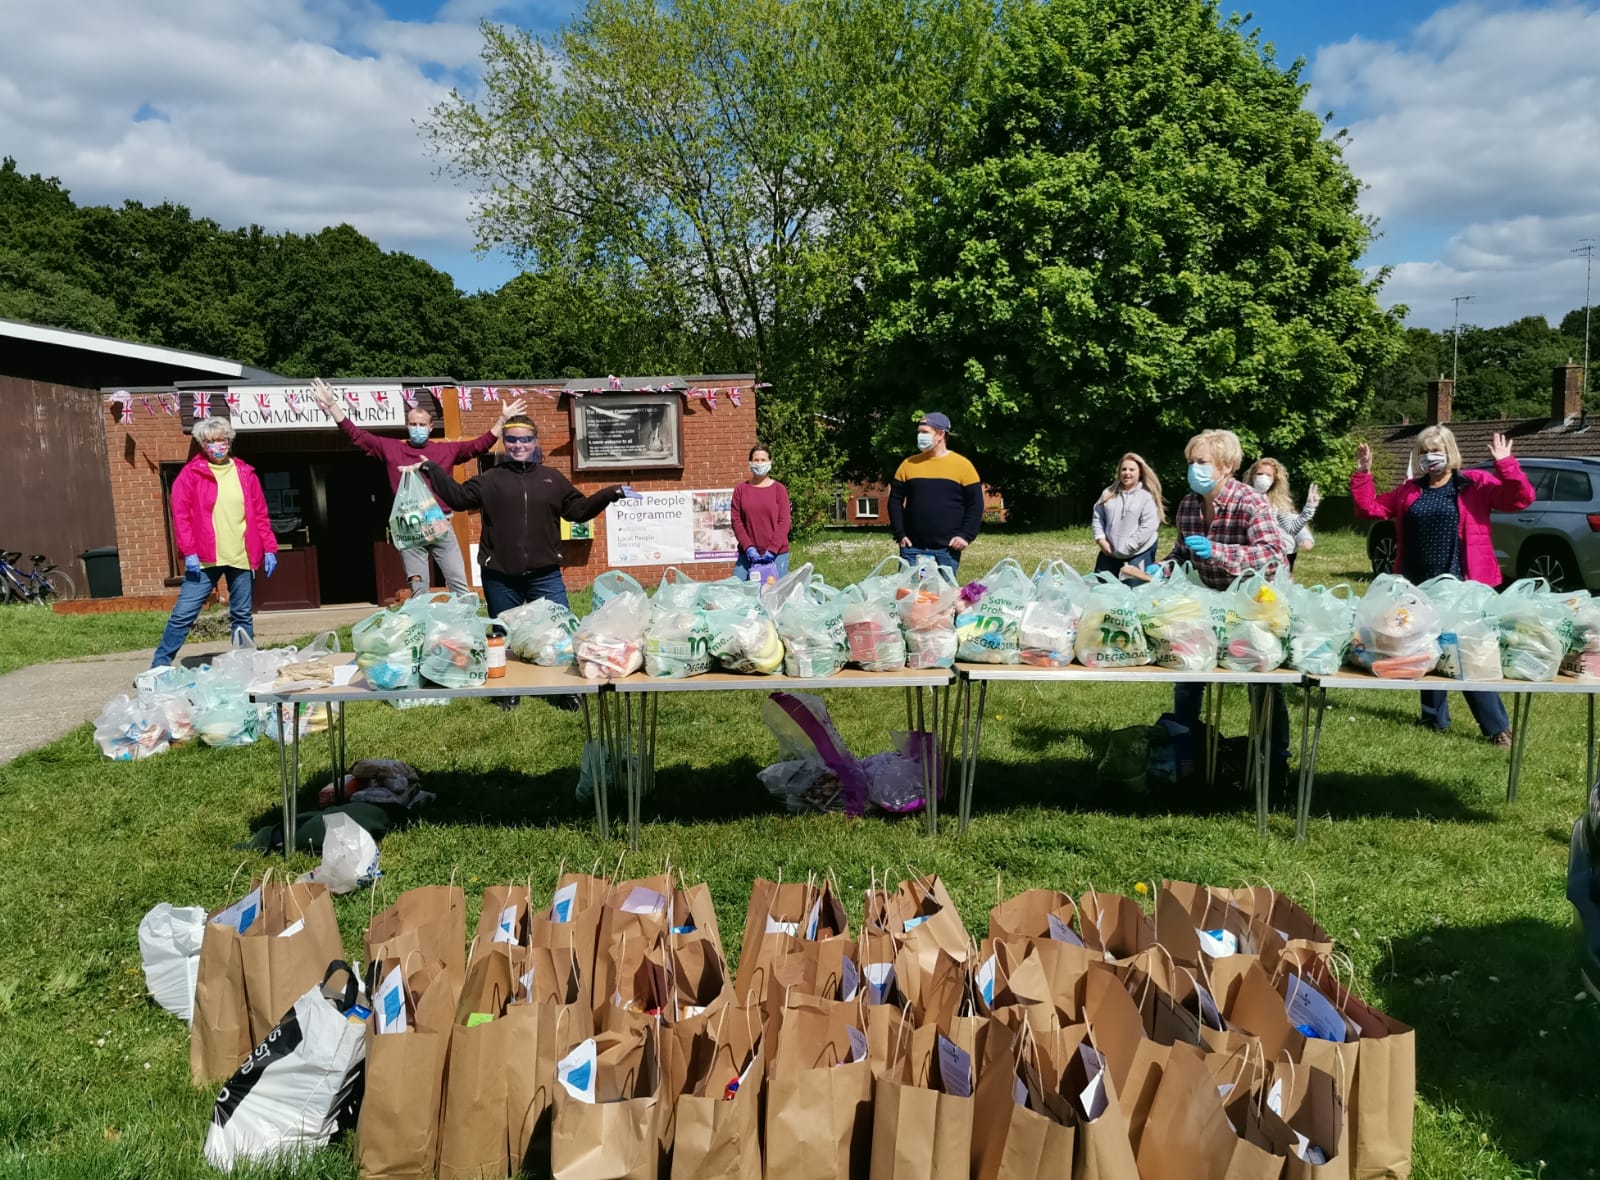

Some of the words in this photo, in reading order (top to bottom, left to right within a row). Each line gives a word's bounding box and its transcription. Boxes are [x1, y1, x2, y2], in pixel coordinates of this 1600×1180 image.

[284, 387, 348, 403] HARST
[240, 407, 331, 425] COMMUNITY
[342, 407, 396, 423] CHURCH
[646, 495, 686, 508] People
[617, 510, 682, 522] Programme
